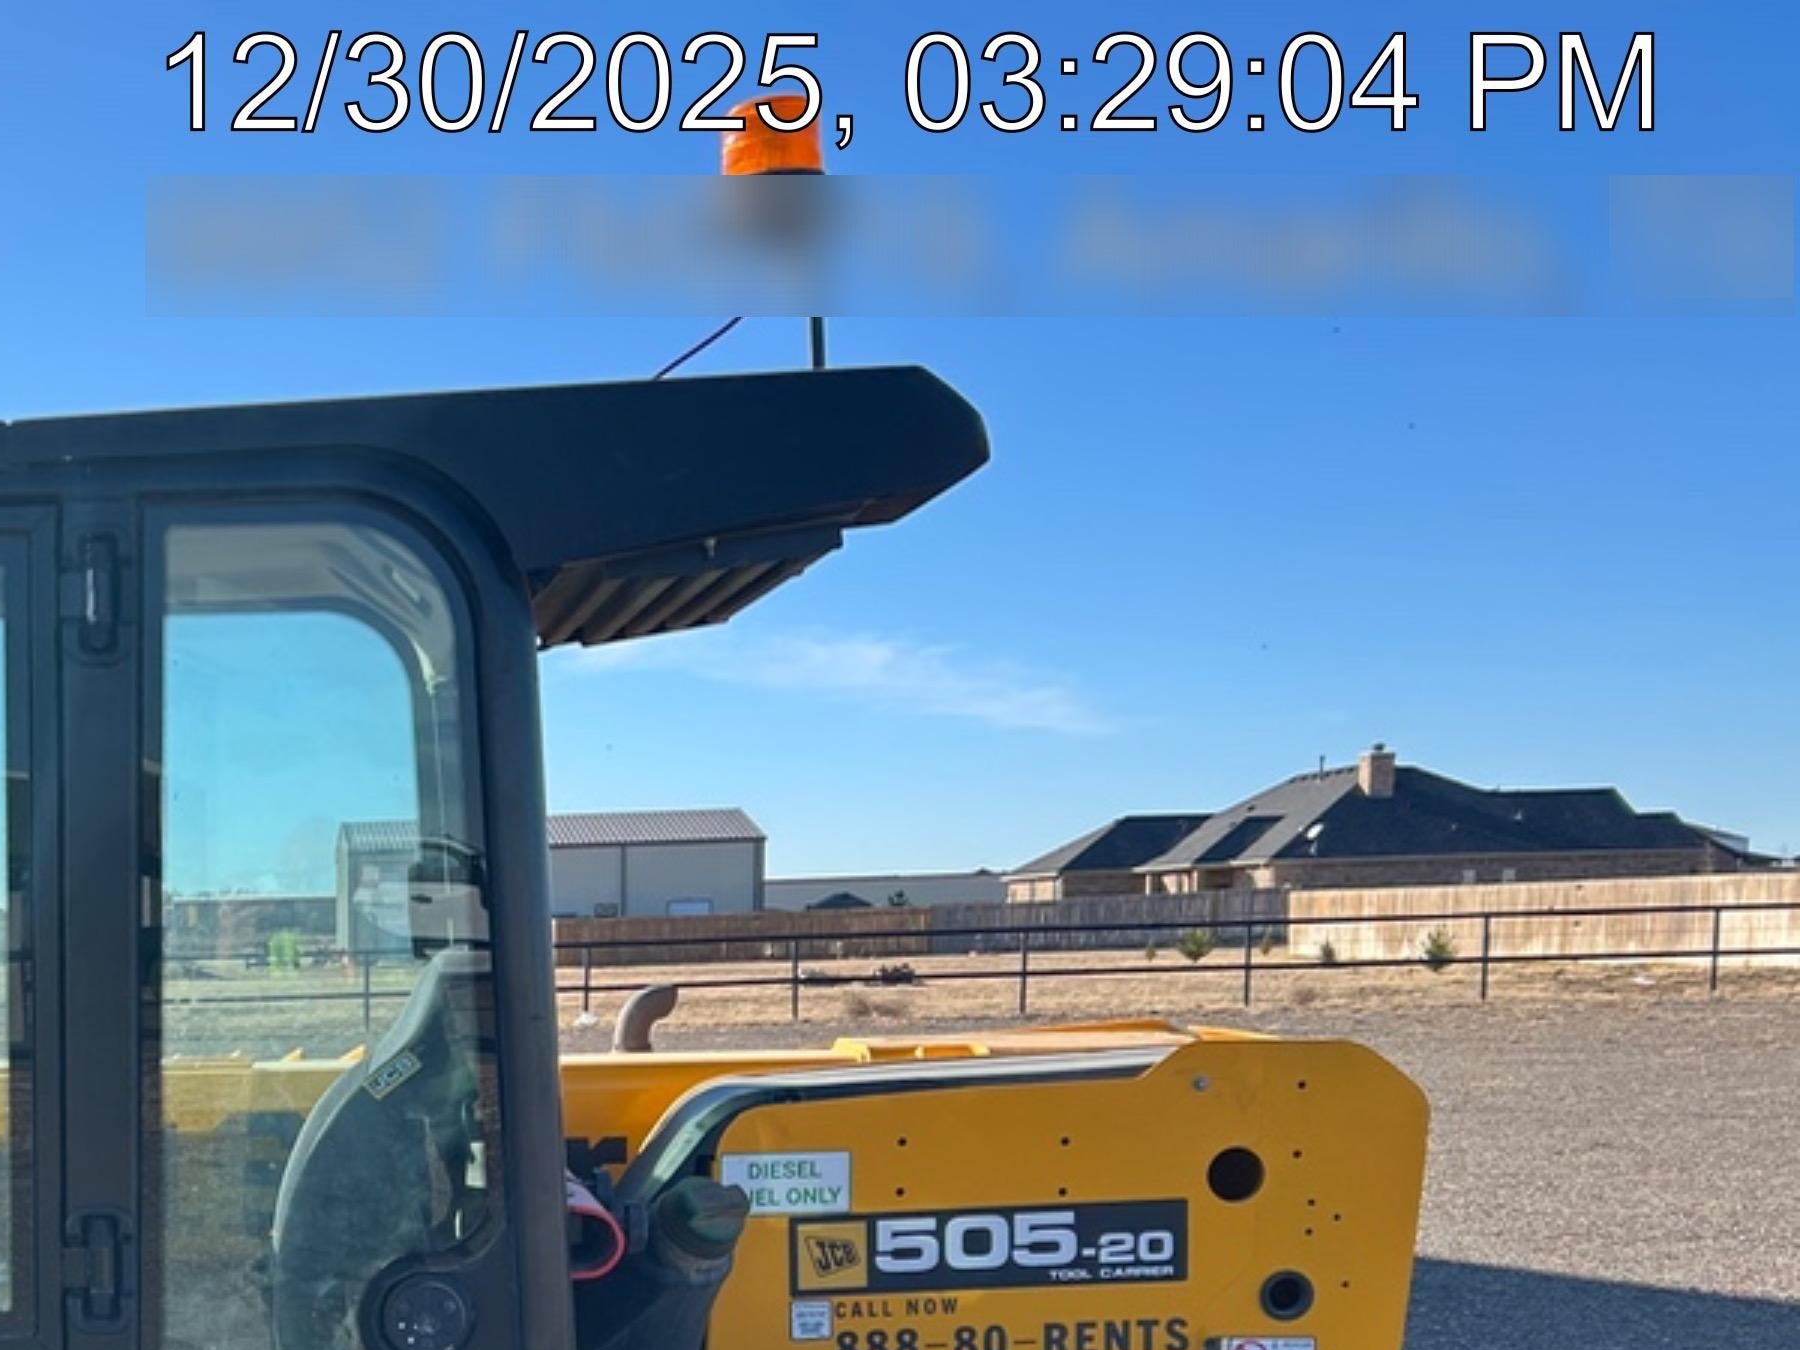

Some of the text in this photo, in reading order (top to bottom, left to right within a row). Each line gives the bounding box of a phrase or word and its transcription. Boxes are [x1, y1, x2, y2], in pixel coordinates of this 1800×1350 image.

[747, 1159, 824, 1180] DIESEL
[785, 1185, 843, 1206] ONLY
[804, 1210, 1174, 1278] JCB 505-20
[1048, 1264, 1175, 1280] TOOL CARRIER
[835, 1297, 959, 1320] CALL NOW
